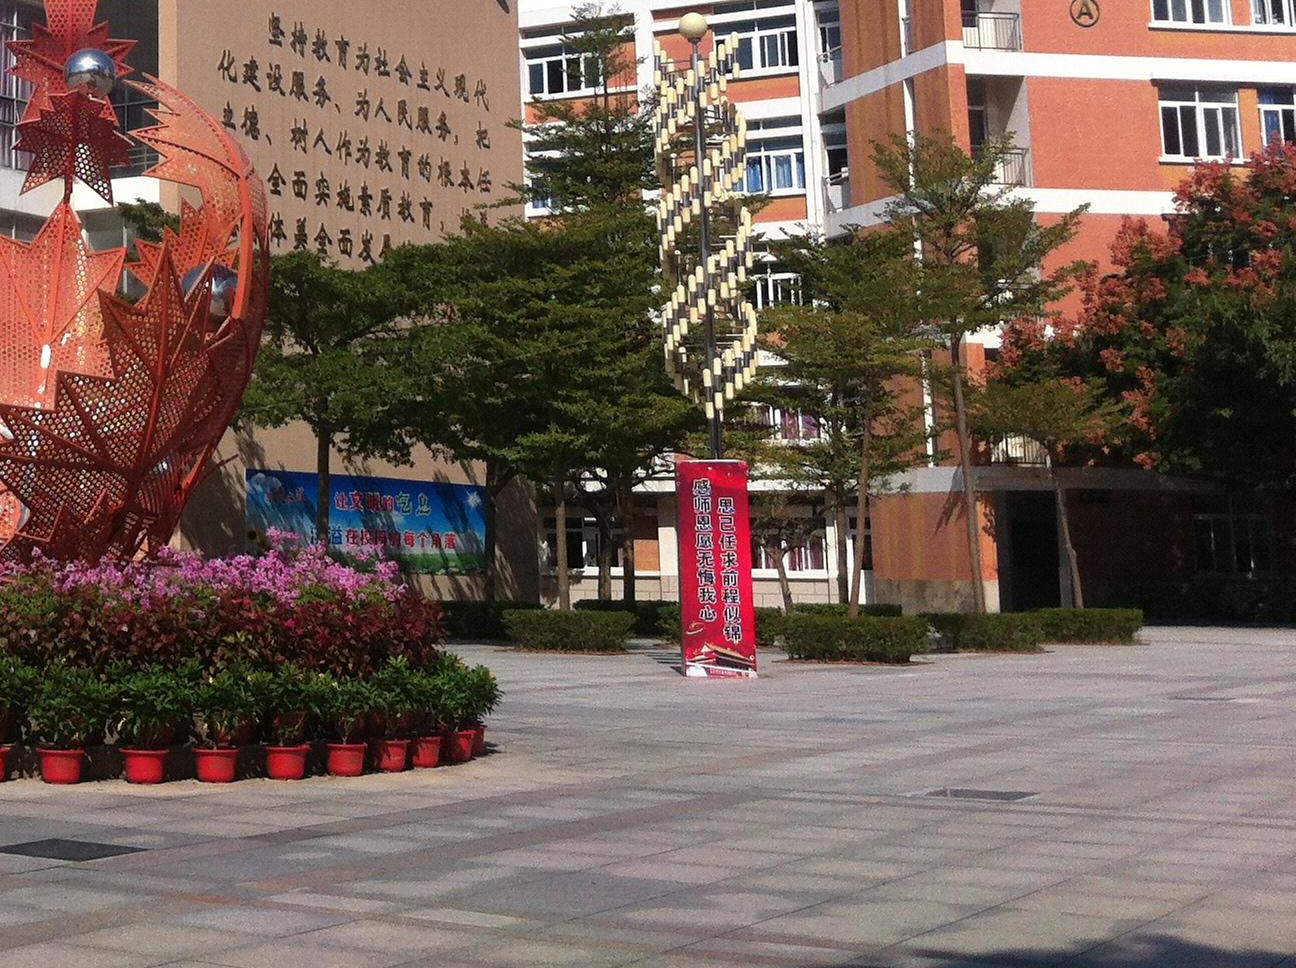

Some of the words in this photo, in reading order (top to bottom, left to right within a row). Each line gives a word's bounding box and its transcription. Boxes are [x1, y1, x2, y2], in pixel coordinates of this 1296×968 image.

[268, 11, 490, 112] 坚持教育为社会主义现代
[311, 526, 457, 550] 溢在校园的每个角落
[717, 497, 742, 643] 思己任求前程似锦
